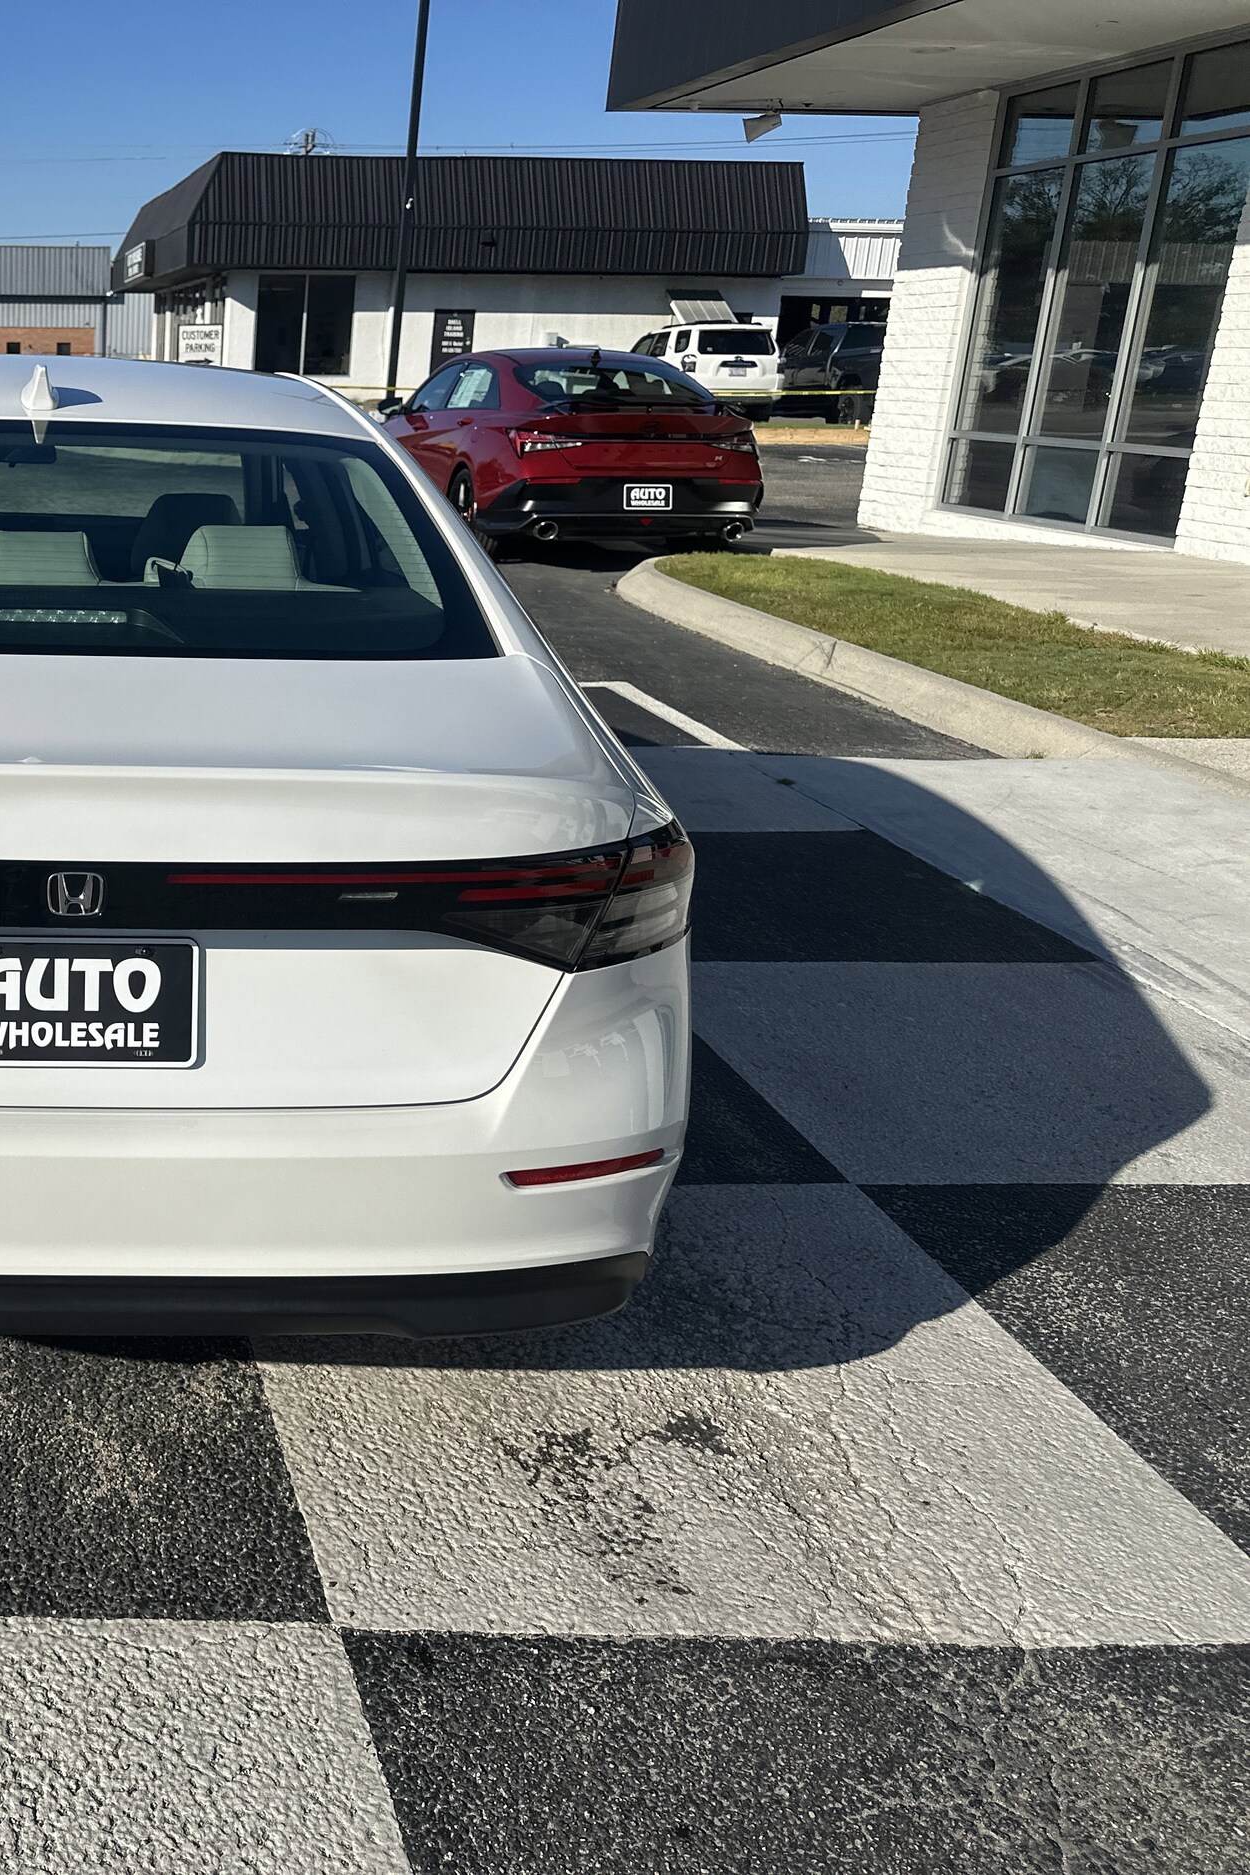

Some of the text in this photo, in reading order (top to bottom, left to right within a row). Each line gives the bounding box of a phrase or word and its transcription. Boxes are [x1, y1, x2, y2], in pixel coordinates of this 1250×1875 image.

[181, 330, 220, 340] CUSTOMER
[185, 343, 216, 352] PARKING
[630, 488, 666, 500] AUTO
